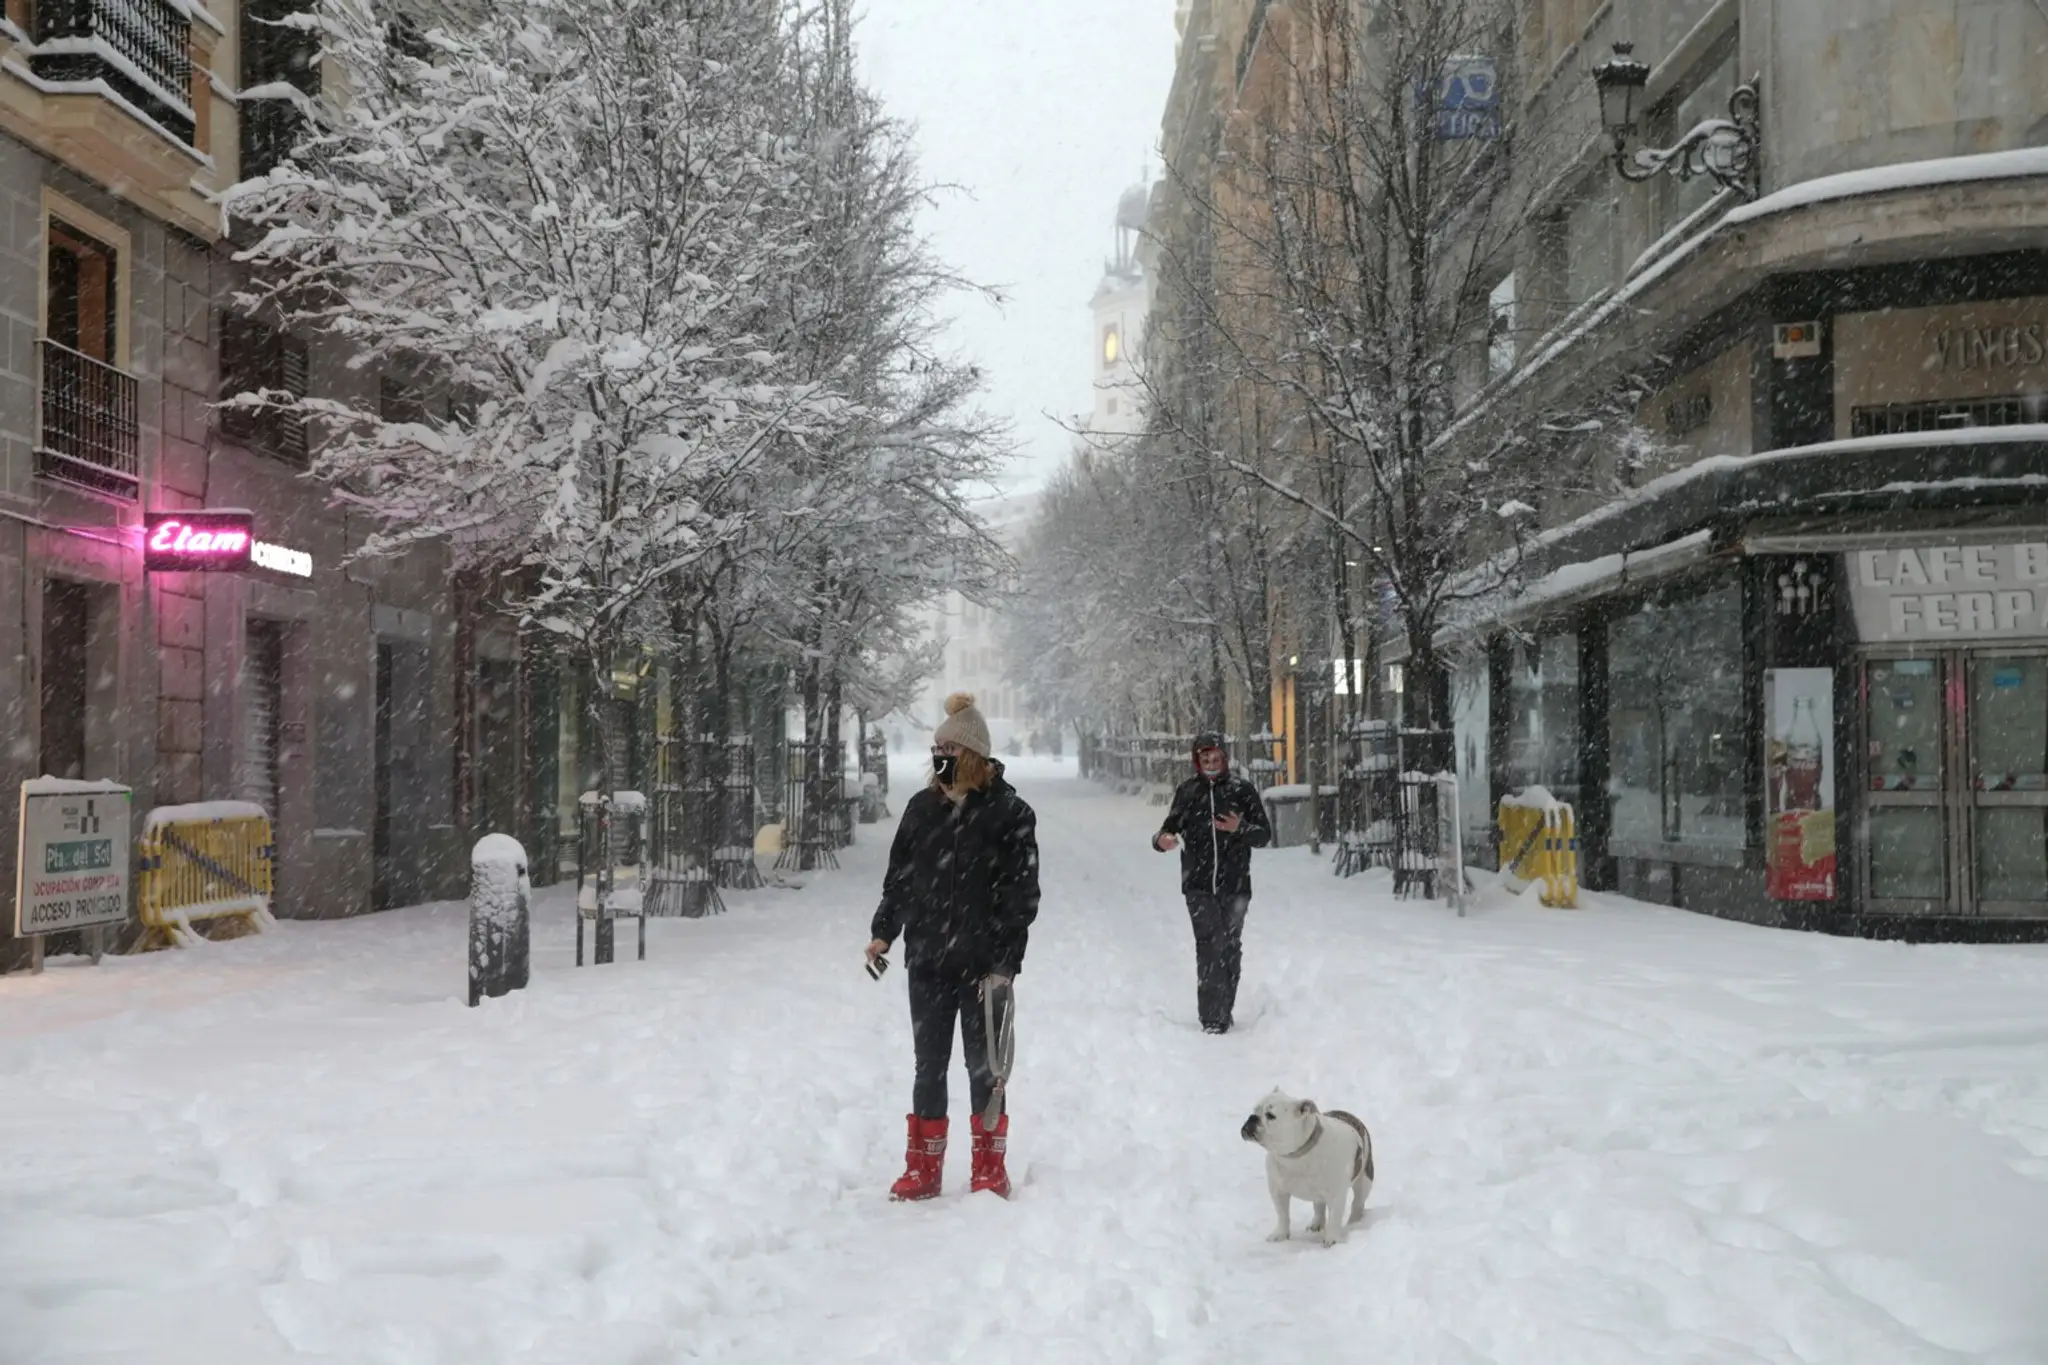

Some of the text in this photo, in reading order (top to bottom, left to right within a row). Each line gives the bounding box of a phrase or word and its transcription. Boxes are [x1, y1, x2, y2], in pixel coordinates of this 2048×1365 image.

[1936, 322, 2044, 373] VINOS
[150, 519, 247, 552] Etam
[1858, 545, 1998, 588] CAFE
[1889, 589, 2048, 634] FERP
[73, 842, 88, 866] del
[95, 841, 110, 863] Sol
[82, 874, 120, 892] COMPETA
[31, 900, 71, 924] ACCESO
